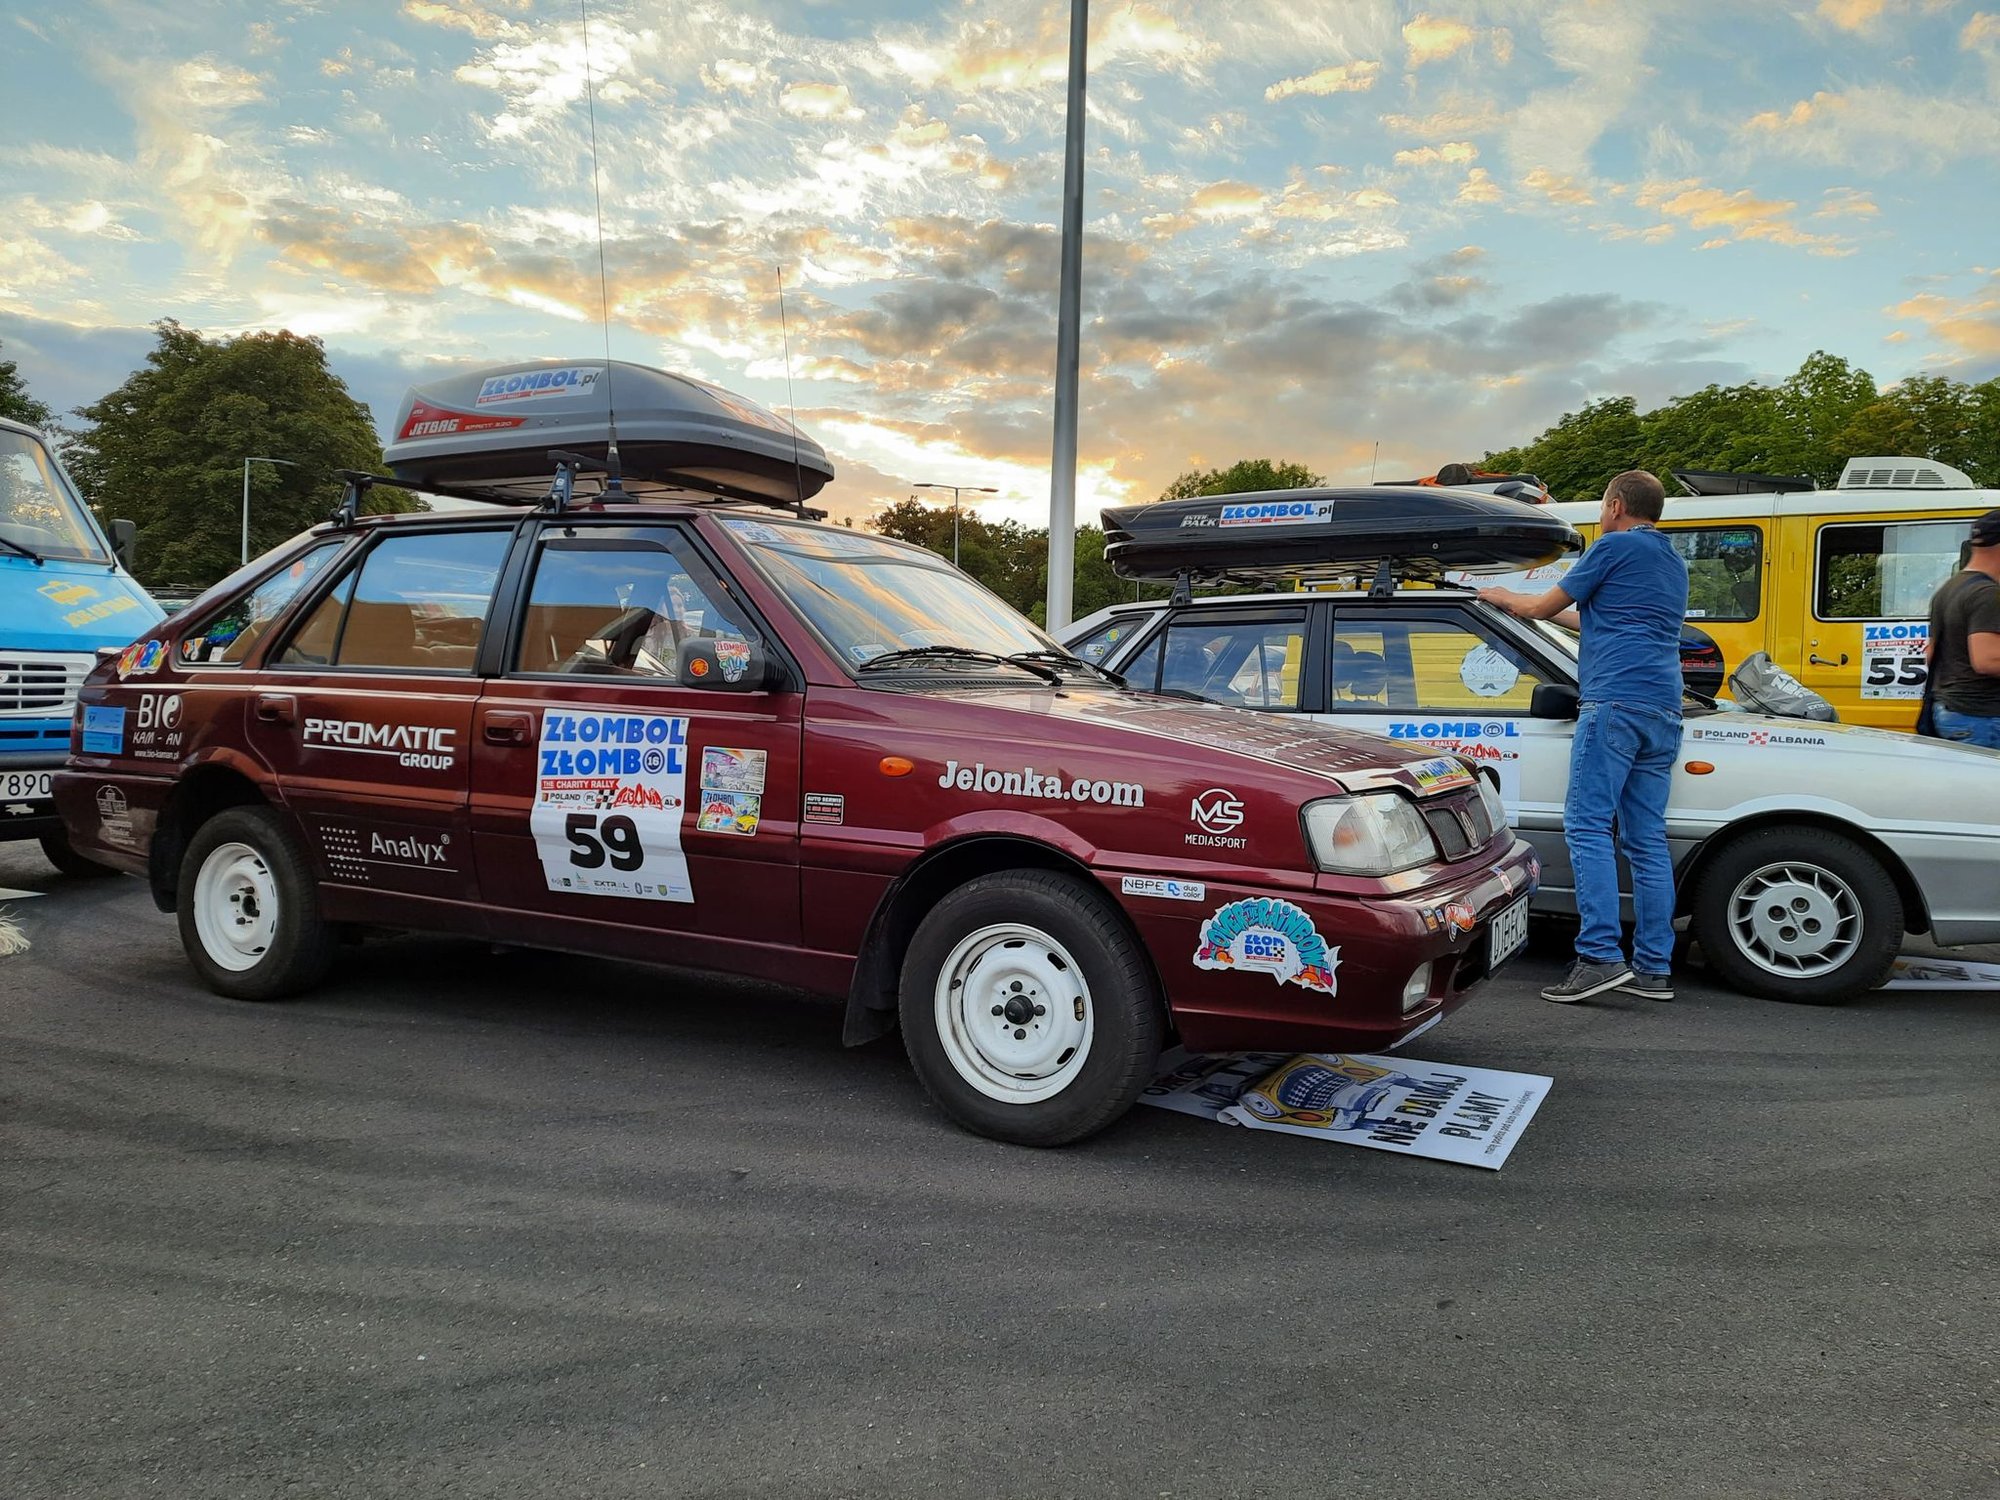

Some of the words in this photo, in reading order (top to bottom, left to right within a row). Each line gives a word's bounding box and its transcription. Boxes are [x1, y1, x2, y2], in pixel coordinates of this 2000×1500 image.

[409, 419, 459, 436] JETBAG
[1223, 502, 1332, 519] ZŁOMBOL.pl
[1180, 519, 1218, 528] PACK
[1866, 624, 1930, 640] ZŁOM
[1866, 657, 1928, 686] 55
[133, 731, 155, 744] KAM
[165, 732, 182, 746] AN
[303, 718, 456, 752] PROMATIC
[544, 716, 685, 745] ZŁOMBOL
[1704, 730, 1750, 739] POLAND
[1769, 735, 1826, 745] ALBANIA
[399, 752, 454, 770] GROUP
[543, 780, 554, 789] THE
[556, 780, 590, 790] CHARITY
[591, 779, 615, 789] RALLY
[938, 760, 1145, 807] Jelonka.com
[550, 792, 581, 801] POLAND
[1191, 798, 1245, 825] MS
[565, 813, 644, 872] 59
[1185, 833, 1247, 849] MEDIASPORT
[1124, 878, 1165, 892] NBPE
[1244, 945, 1273, 957] BOL
[1394, 1072, 1468, 1119] DAWAJ
[1438, 1090, 1510, 1141] PLAMY
[1367, 1116, 1428, 1146] NIE
